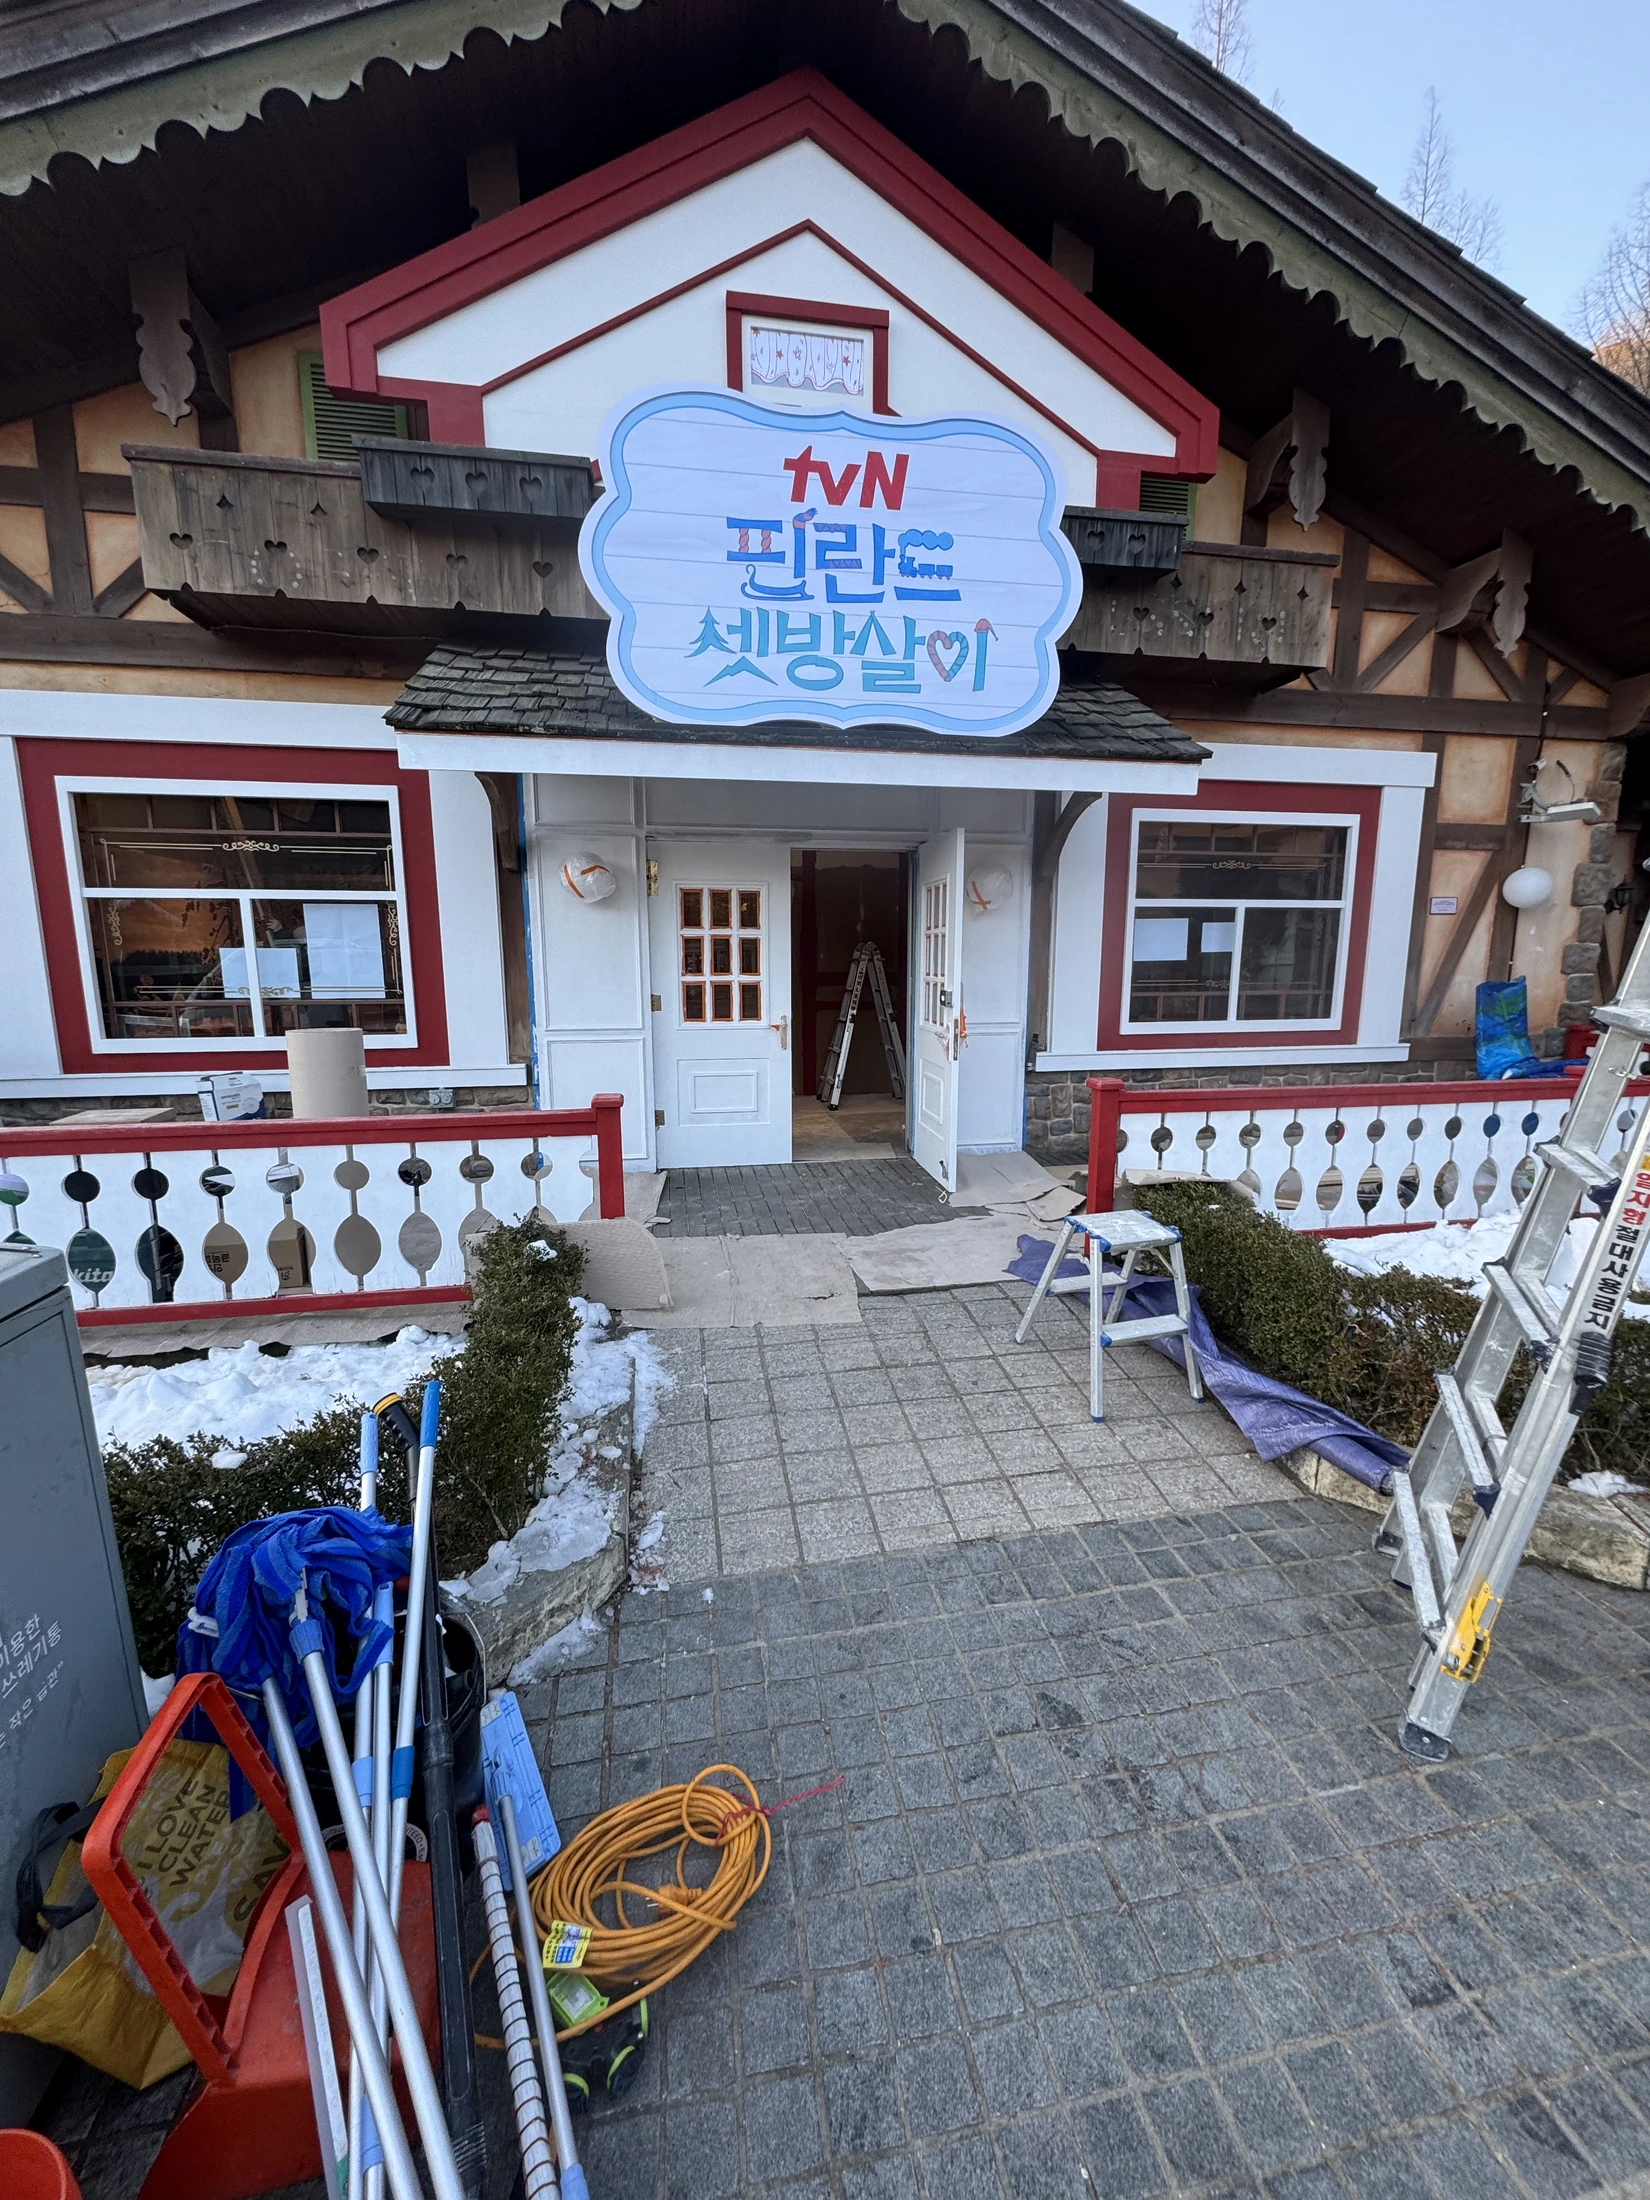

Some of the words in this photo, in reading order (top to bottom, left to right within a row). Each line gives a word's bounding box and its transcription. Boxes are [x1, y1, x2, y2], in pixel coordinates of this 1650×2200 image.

[783, 445, 910, 511] tvN
[727, 508, 962, 603] 핀란드
[684, 605, 999, 694] 셋방살이
[2, 1621, 62, 1699] 쓰레기통
[137, 1860, 153, 1870] I
[145, 1780, 198, 1854] LOVE
[158, 1784, 216, 1873] CLEAN
